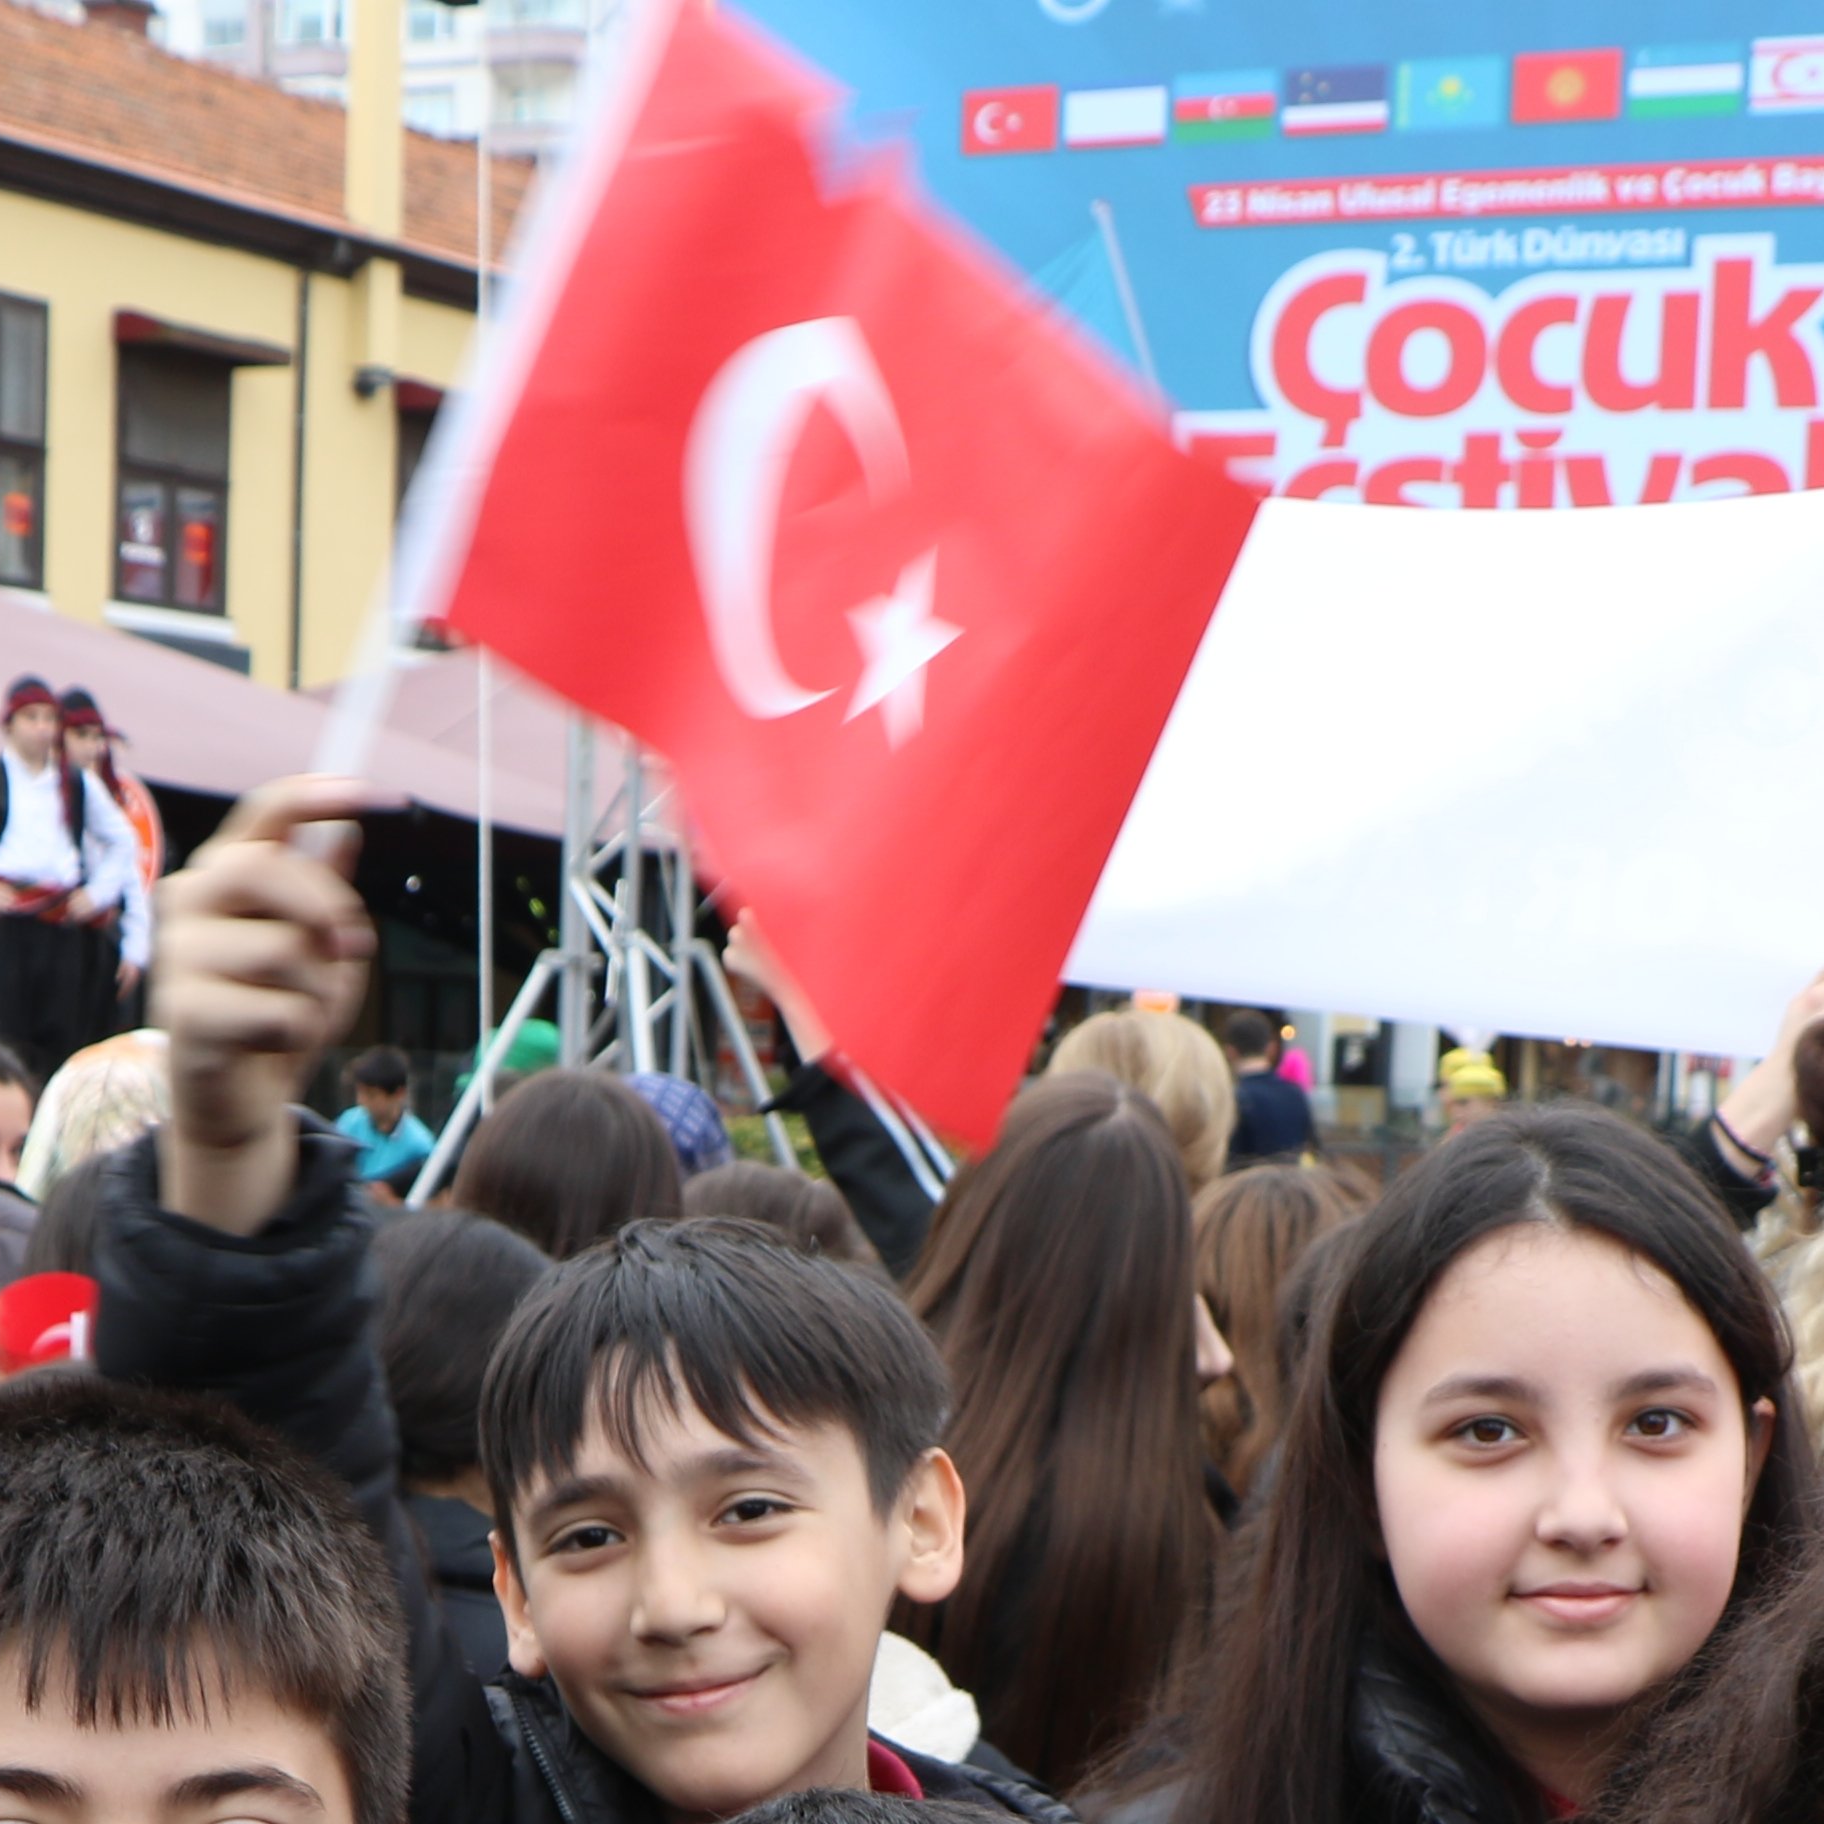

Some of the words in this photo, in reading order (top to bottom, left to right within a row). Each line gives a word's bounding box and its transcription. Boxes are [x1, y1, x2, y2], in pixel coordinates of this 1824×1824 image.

[1204, 191, 1240, 221] 23
[1246, 188, 1331, 217] Nisan
[1339, 180, 1433, 213] Ulusal
[1443, 172, 1607, 212] Egemenlik
[1618, 177, 1655, 200] ve
[1664, 164, 1764, 203] Çocuk
[1391, 232, 1425, 267] 2.
[1429, 226, 1519, 266] Türk
[1524, 225, 1686, 265] Dünyası
